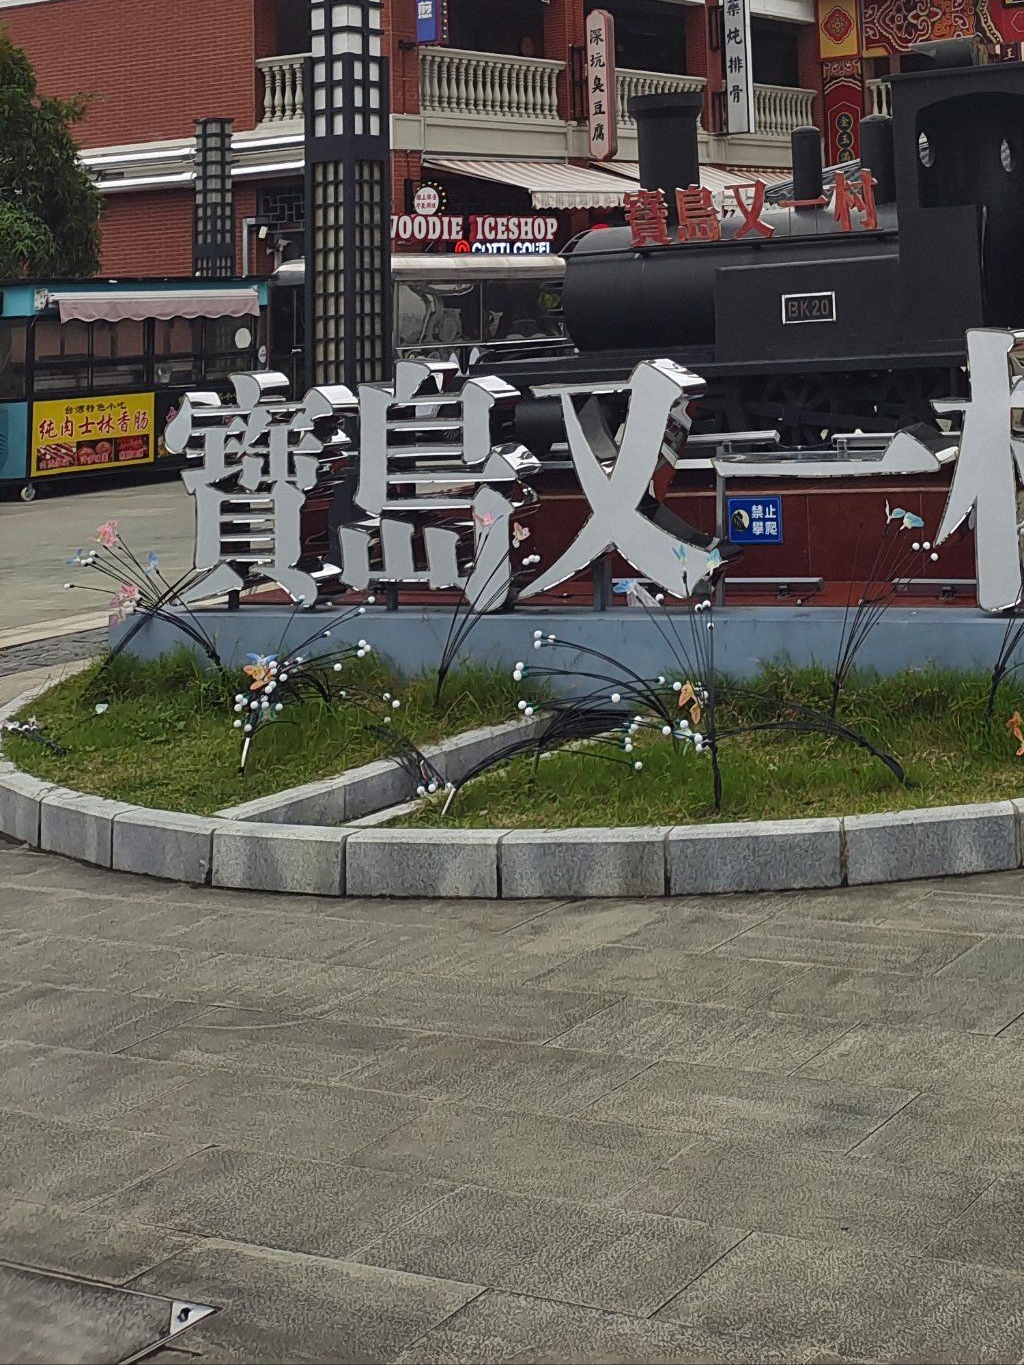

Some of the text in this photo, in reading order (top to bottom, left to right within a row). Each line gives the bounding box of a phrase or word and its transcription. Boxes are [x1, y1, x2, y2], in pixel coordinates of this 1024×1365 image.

[589, 28, 606, 142] 深坑臭豆腐
[624, 168, 878, 247] 寶島又一村
[476, 217, 558, 240] ICESHOP
[788, 299, 829, 317] BK20
[65, 401, 126, 415] 台湾特色小吃
[39, 410, 149, 440] 纯肉士林香肠
[751, 504, 777, 519] 禁止
[752, 521, 778, 536] 攀爬
